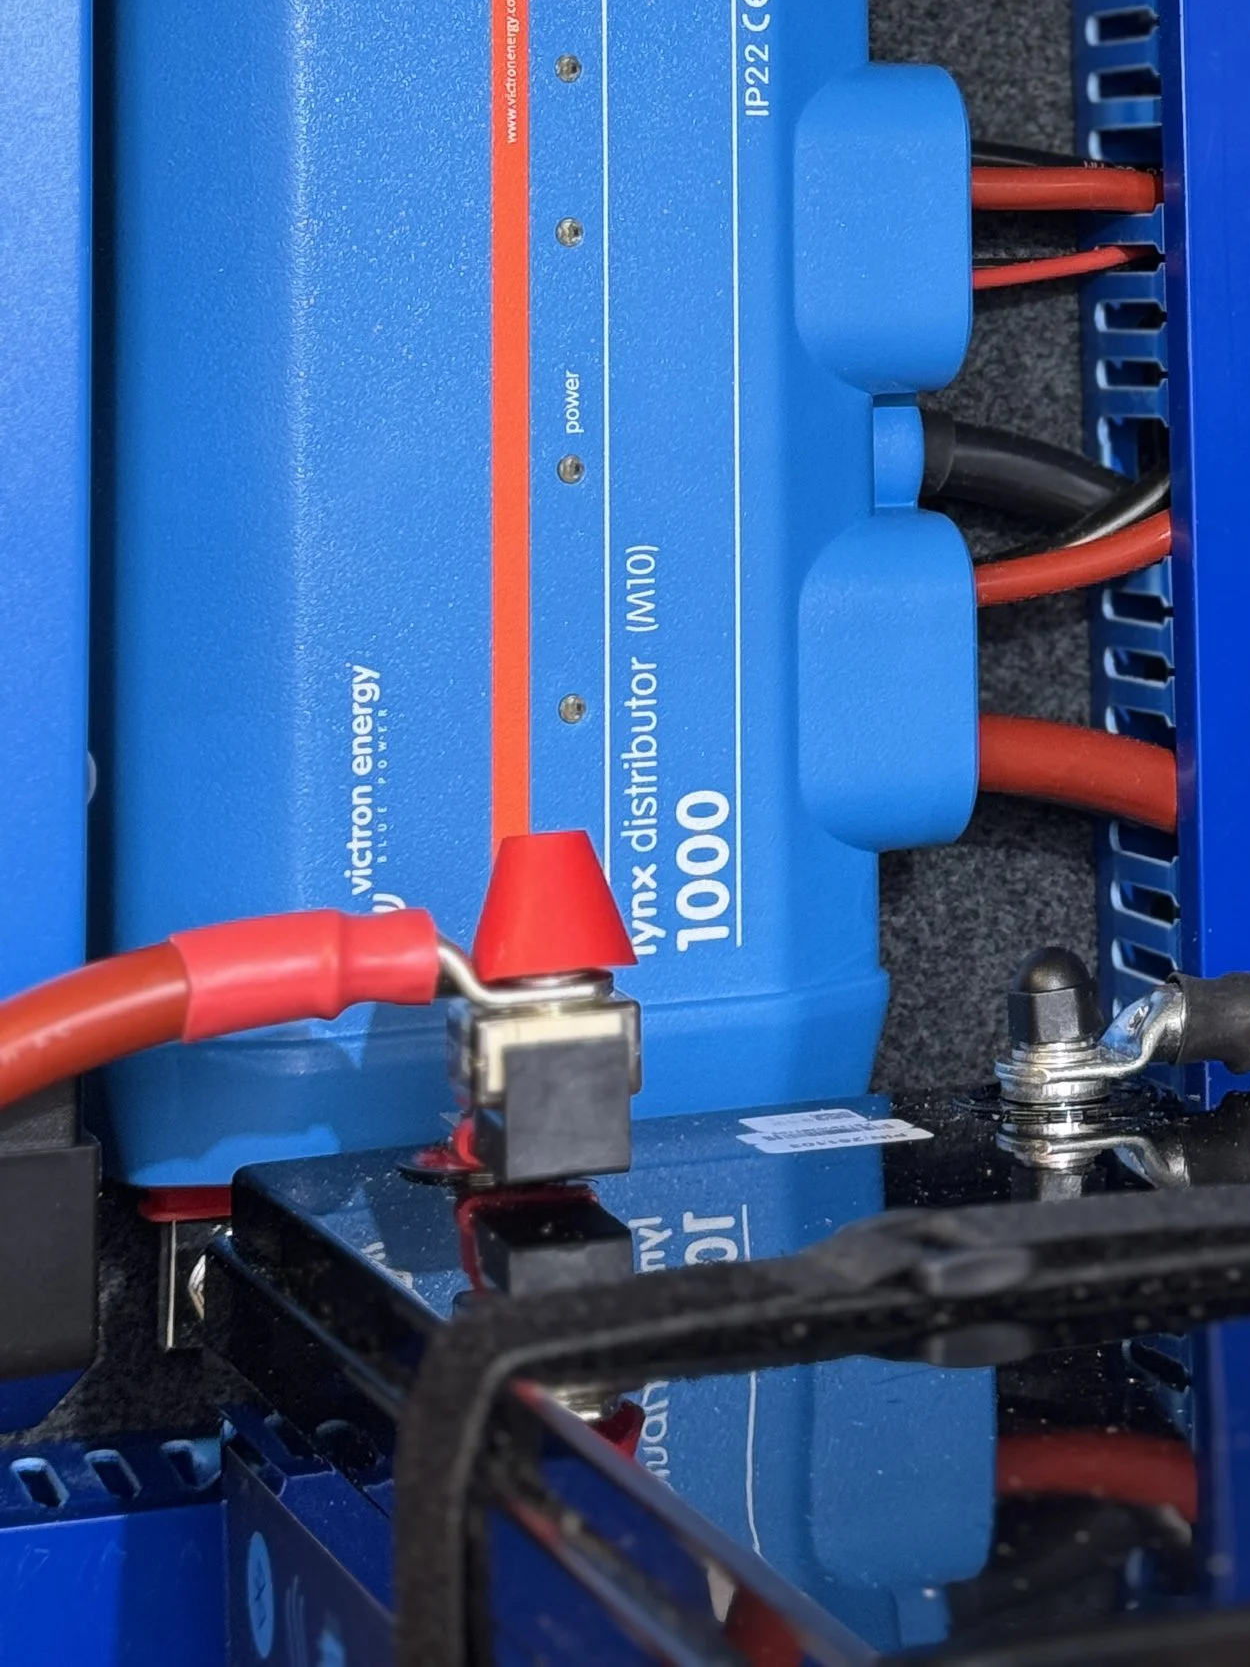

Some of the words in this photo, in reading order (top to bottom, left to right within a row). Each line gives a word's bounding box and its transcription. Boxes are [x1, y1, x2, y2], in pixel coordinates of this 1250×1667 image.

[745, 43, 769, 116] IP22
[565, 370, 584, 434] power
[627, 544, 660, 633] (M10)
[351, 664, 382, 777] energy
[378, 707, 388, 784] POWER
[621, 656, 657, 853] distributor
[343, 785, 373, 895] victron
[378, 805, 388, 864] BLUE
[675, 790, 730, 951] 1000
[630, 863, 666, 956] lynx
